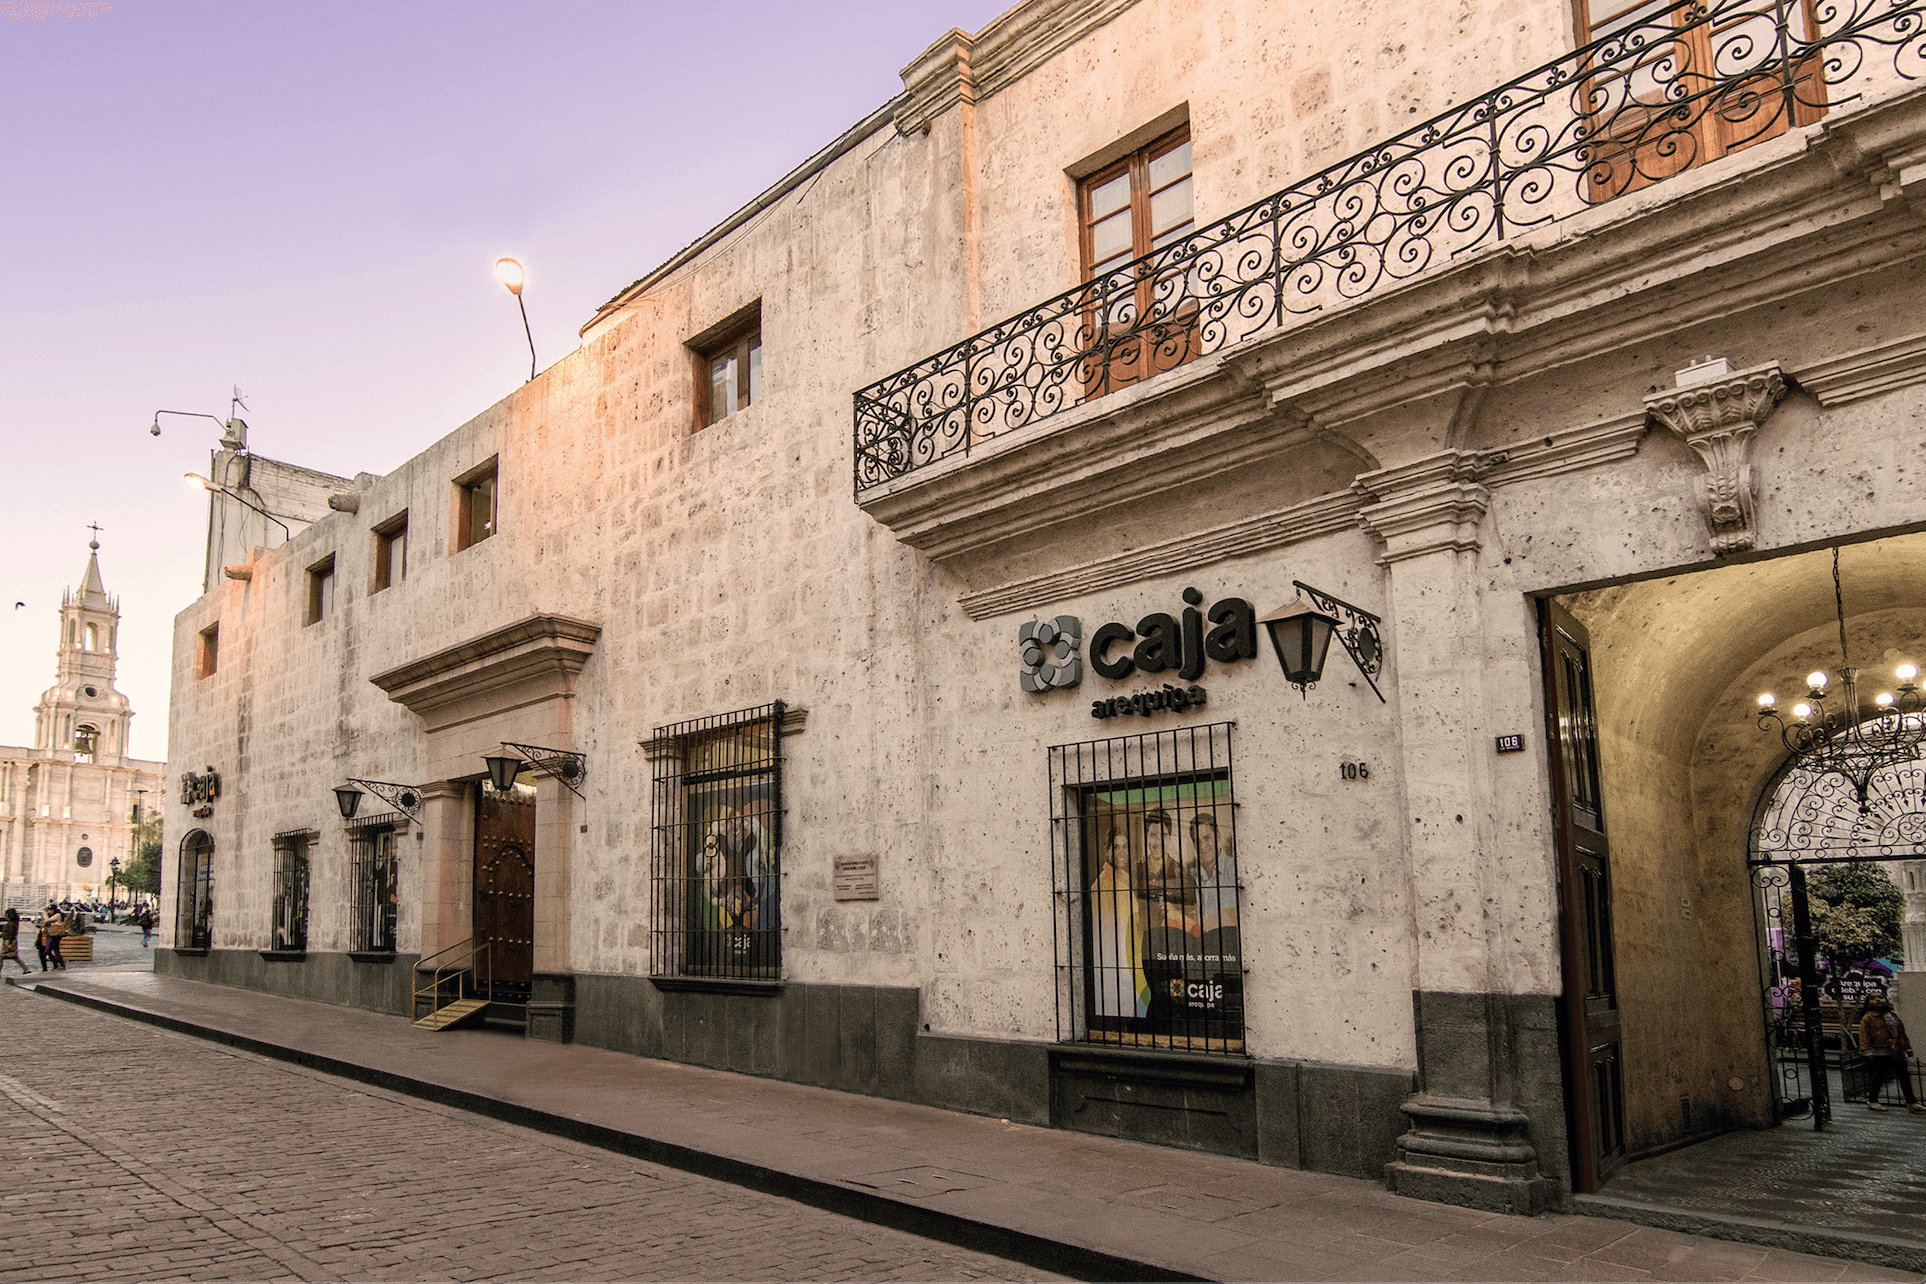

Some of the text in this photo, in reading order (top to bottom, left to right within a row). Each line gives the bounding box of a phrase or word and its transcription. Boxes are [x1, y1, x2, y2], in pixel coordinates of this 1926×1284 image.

[1090, 587, 1257, 681] caja
[1091, 683, 1207, 719] arequipa
[1499, 736, 1518, 747] 106
[1340, 762, 1369, 779] 106
[1156, 953, 1179, 961] Suña
[1187, 980, 1223, 1002] caja
[1188, 1001, 1215, 1009] arequpa
